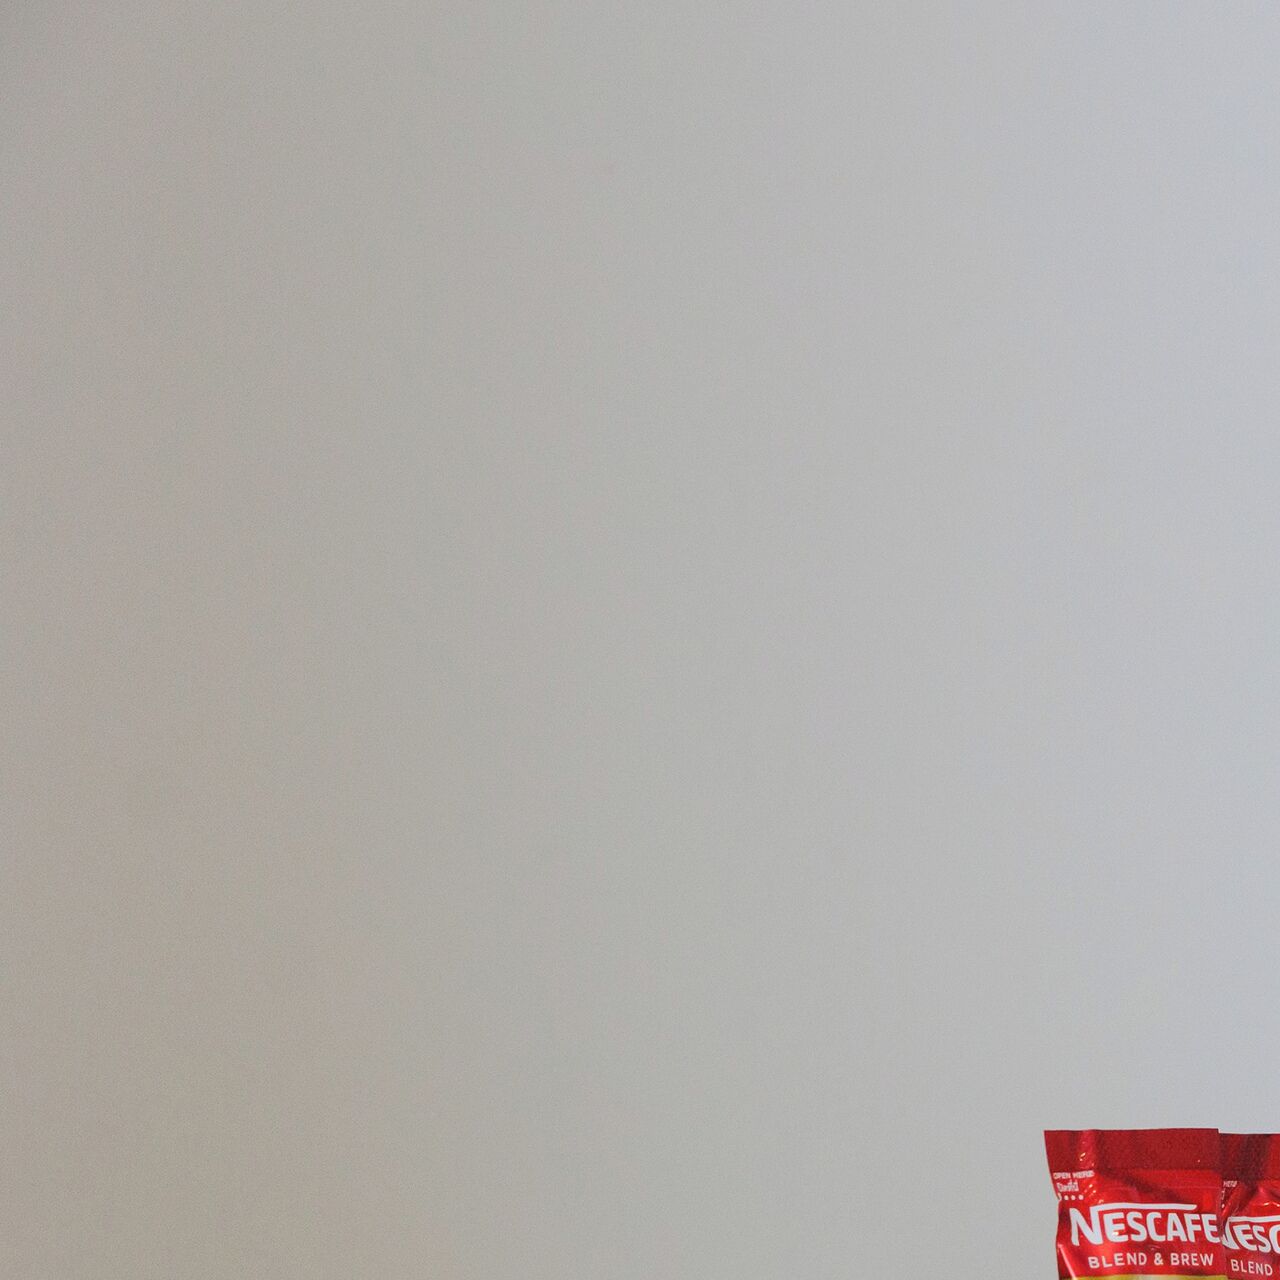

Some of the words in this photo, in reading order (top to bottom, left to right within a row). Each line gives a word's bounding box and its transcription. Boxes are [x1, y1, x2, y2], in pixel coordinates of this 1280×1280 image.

[1088, 1252, 1148, 1269] BLEND
[1154, 1252, 1164, 1266] &
[1170, 1252, 1214, 1266] BREW
[1230, 1259, 1273, 1277] BLEND
